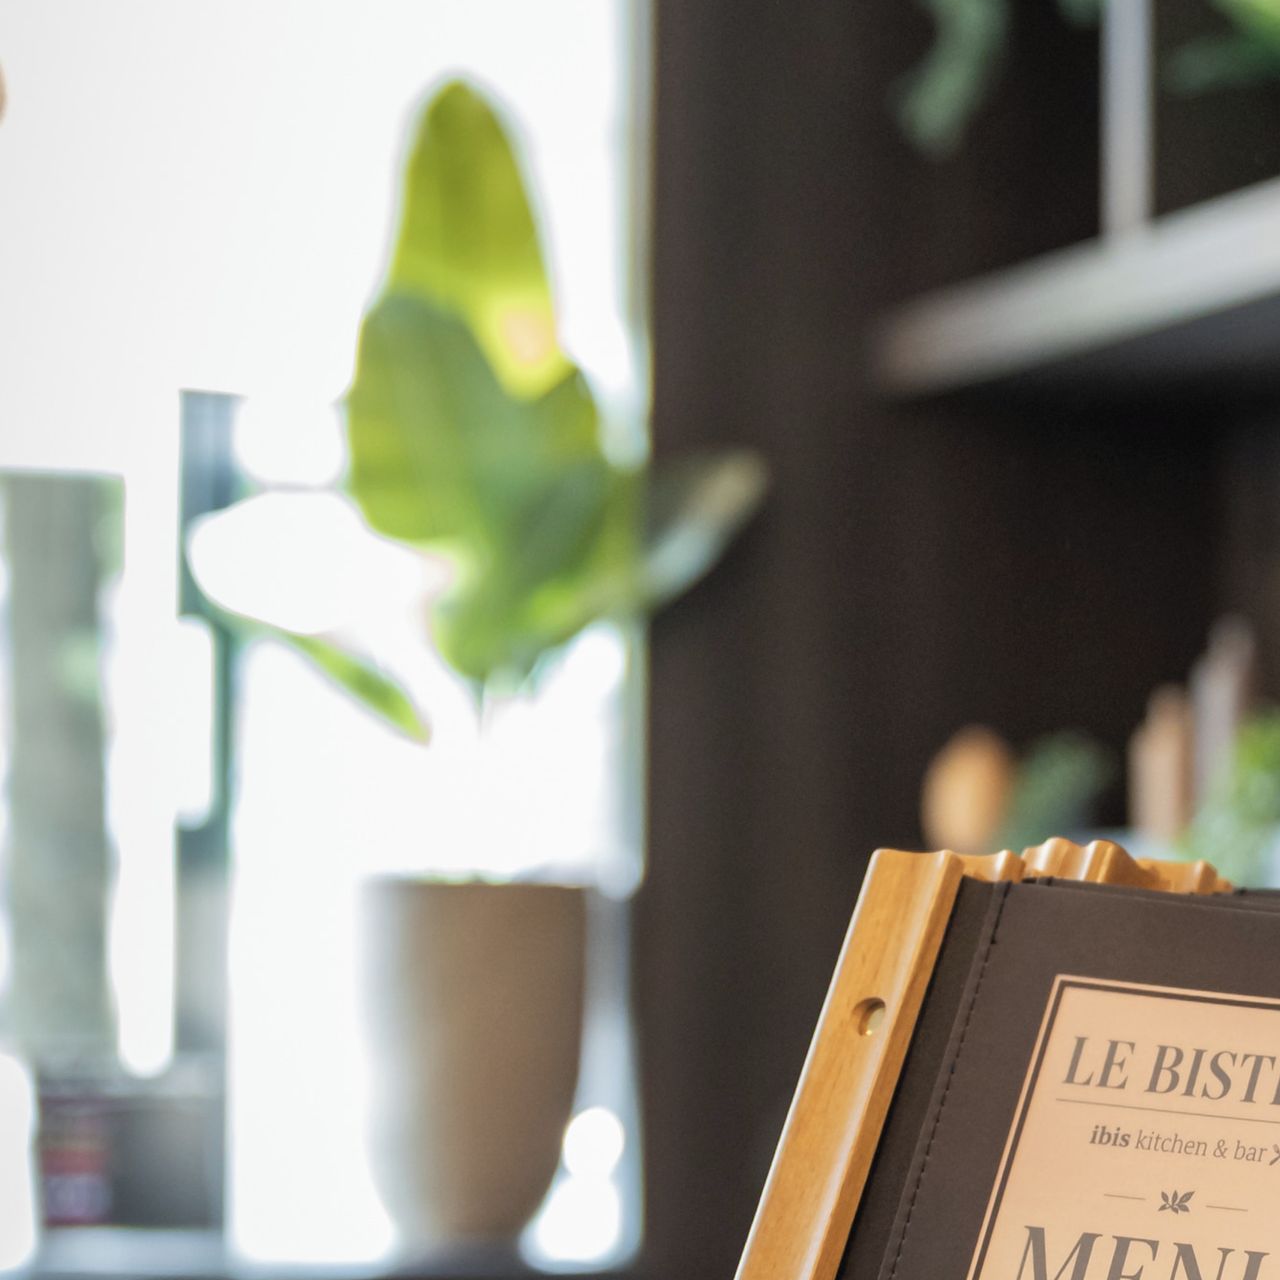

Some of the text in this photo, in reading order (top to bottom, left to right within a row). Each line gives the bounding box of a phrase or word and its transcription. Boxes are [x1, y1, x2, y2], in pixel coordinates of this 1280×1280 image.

[1062, 1036, 1136, 1090] LE
[1089, 1125, 1267, 1162] ibis kitchen & bar
